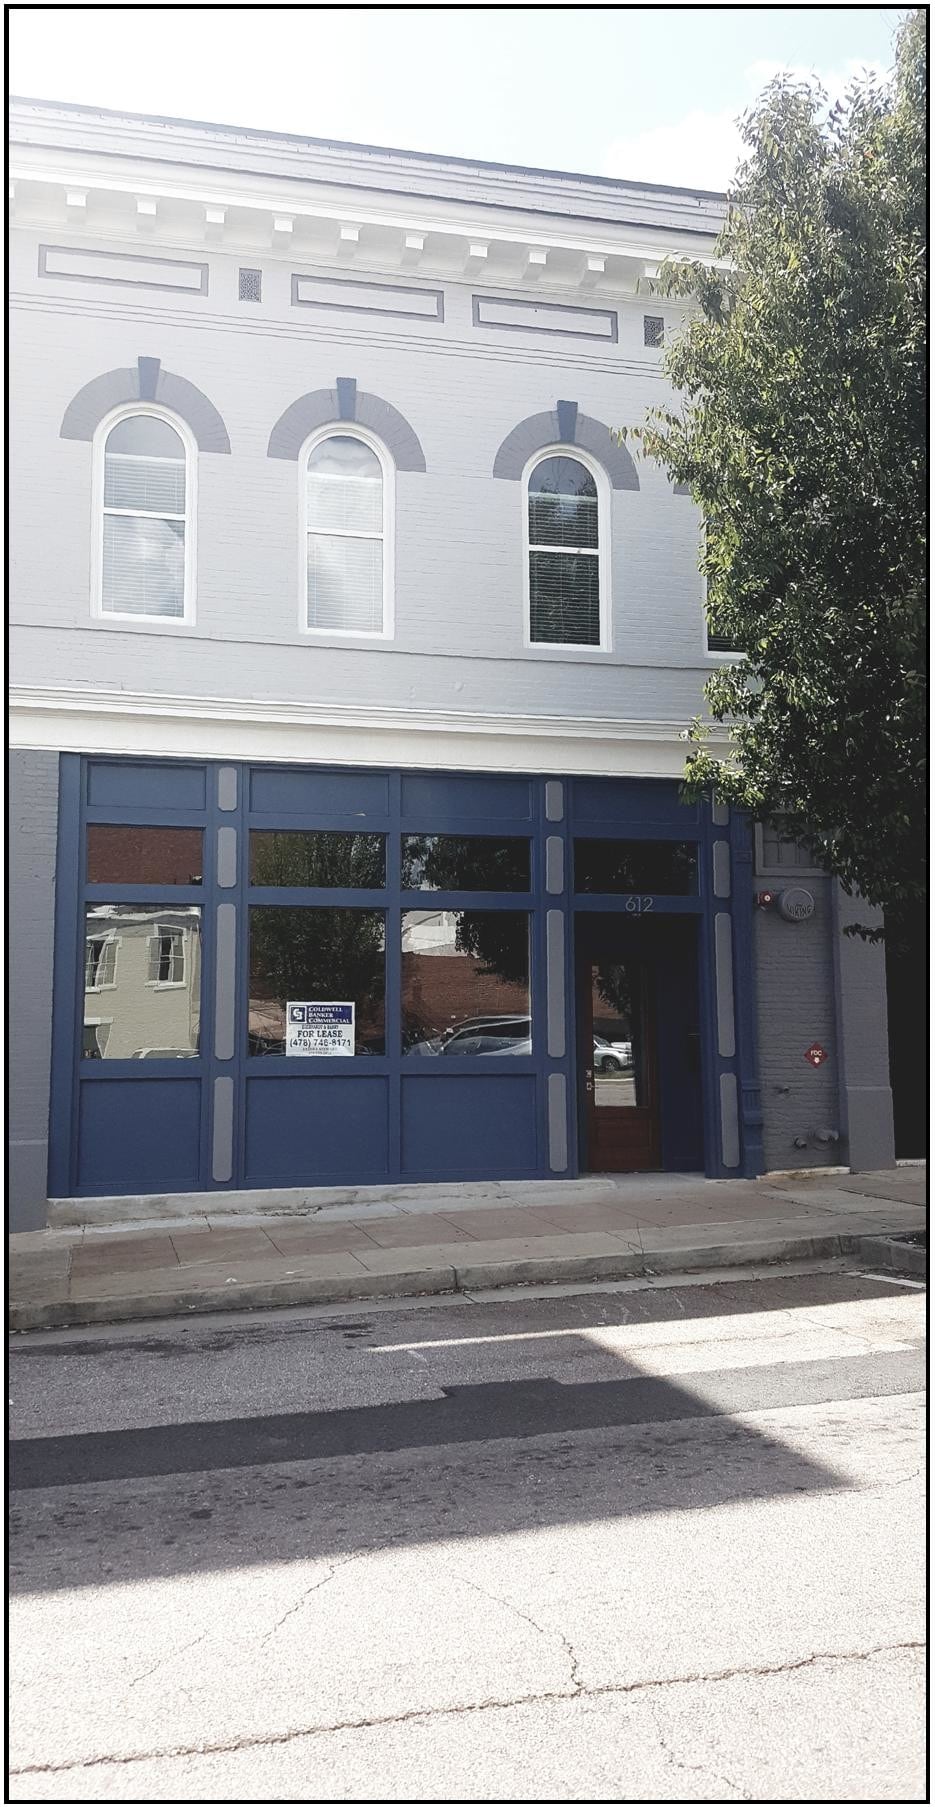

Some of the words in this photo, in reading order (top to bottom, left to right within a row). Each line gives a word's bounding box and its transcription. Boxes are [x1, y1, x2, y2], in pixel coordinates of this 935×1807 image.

[625, 896, 654, 912] 612
[297, 1030, 314, 1038] FOR
[317, 1030, 343, 1038] LEASE
[289, 1038, 311, 1048] (478)
